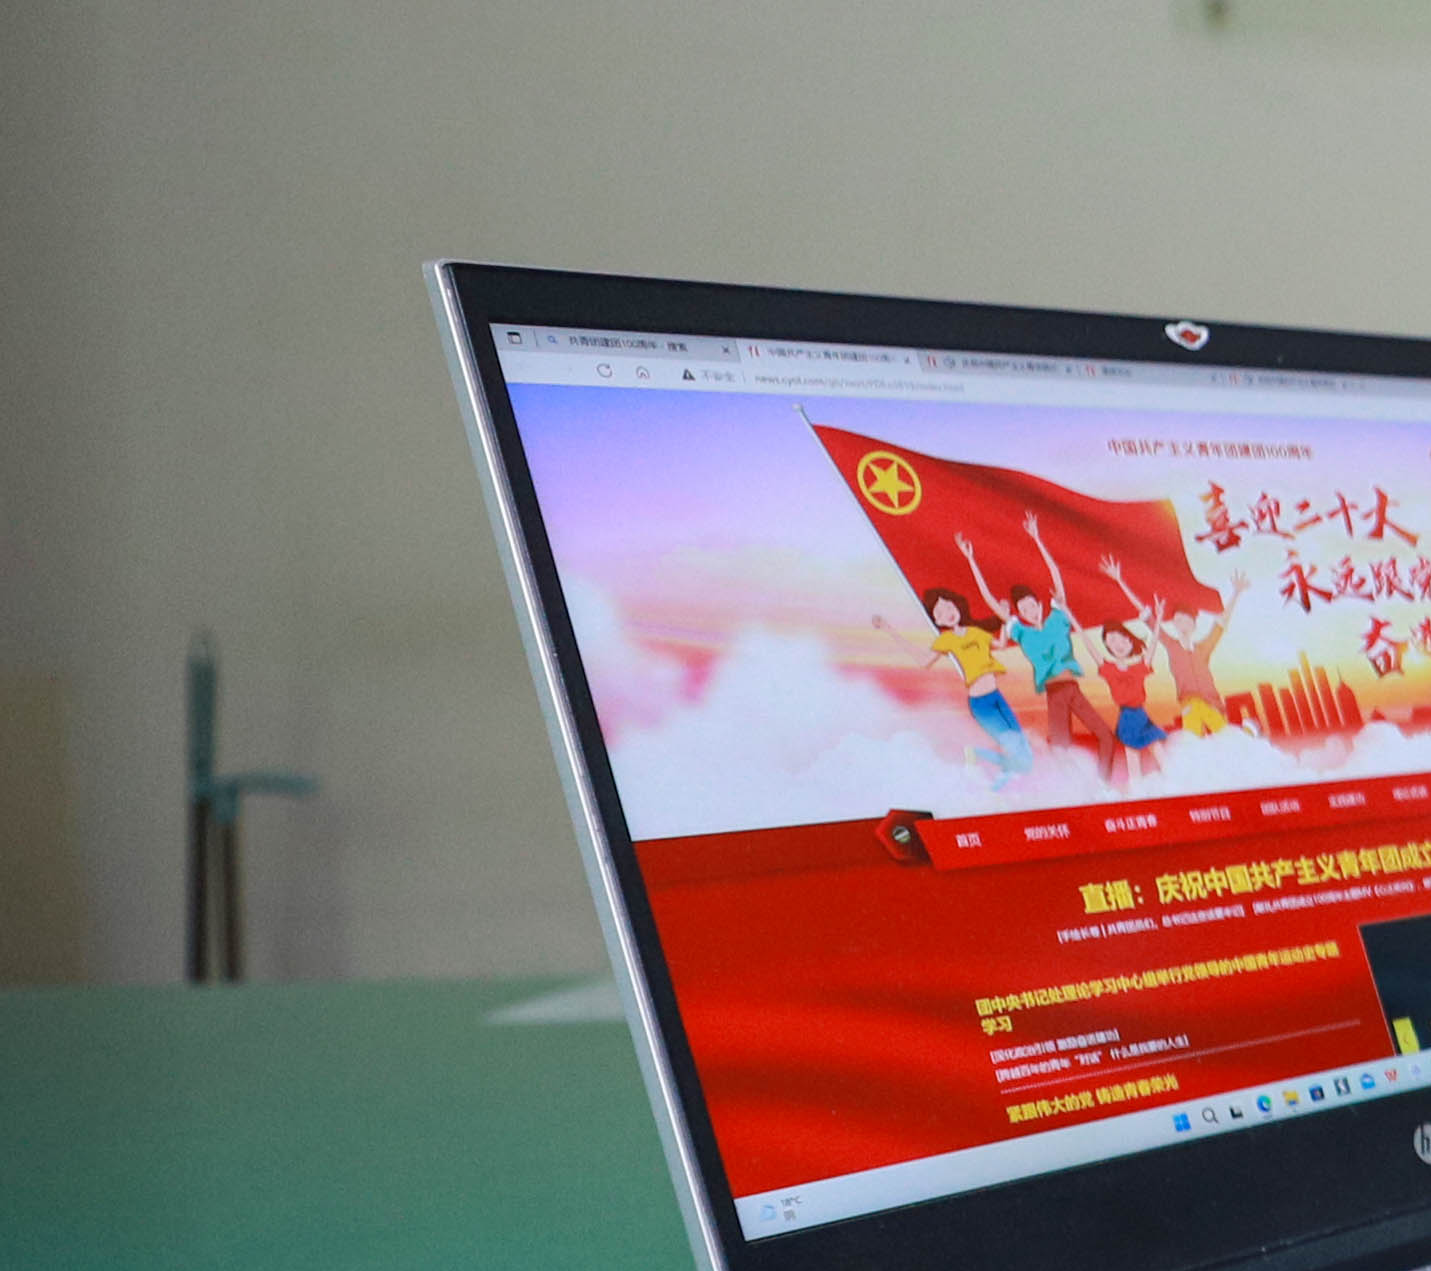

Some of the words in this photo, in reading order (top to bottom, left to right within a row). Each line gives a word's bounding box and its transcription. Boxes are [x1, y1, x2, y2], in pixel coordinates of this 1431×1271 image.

[1195, 479, 1418, 553] 喜迎二十大
[980, 1015, 1013, 1036] 学习
